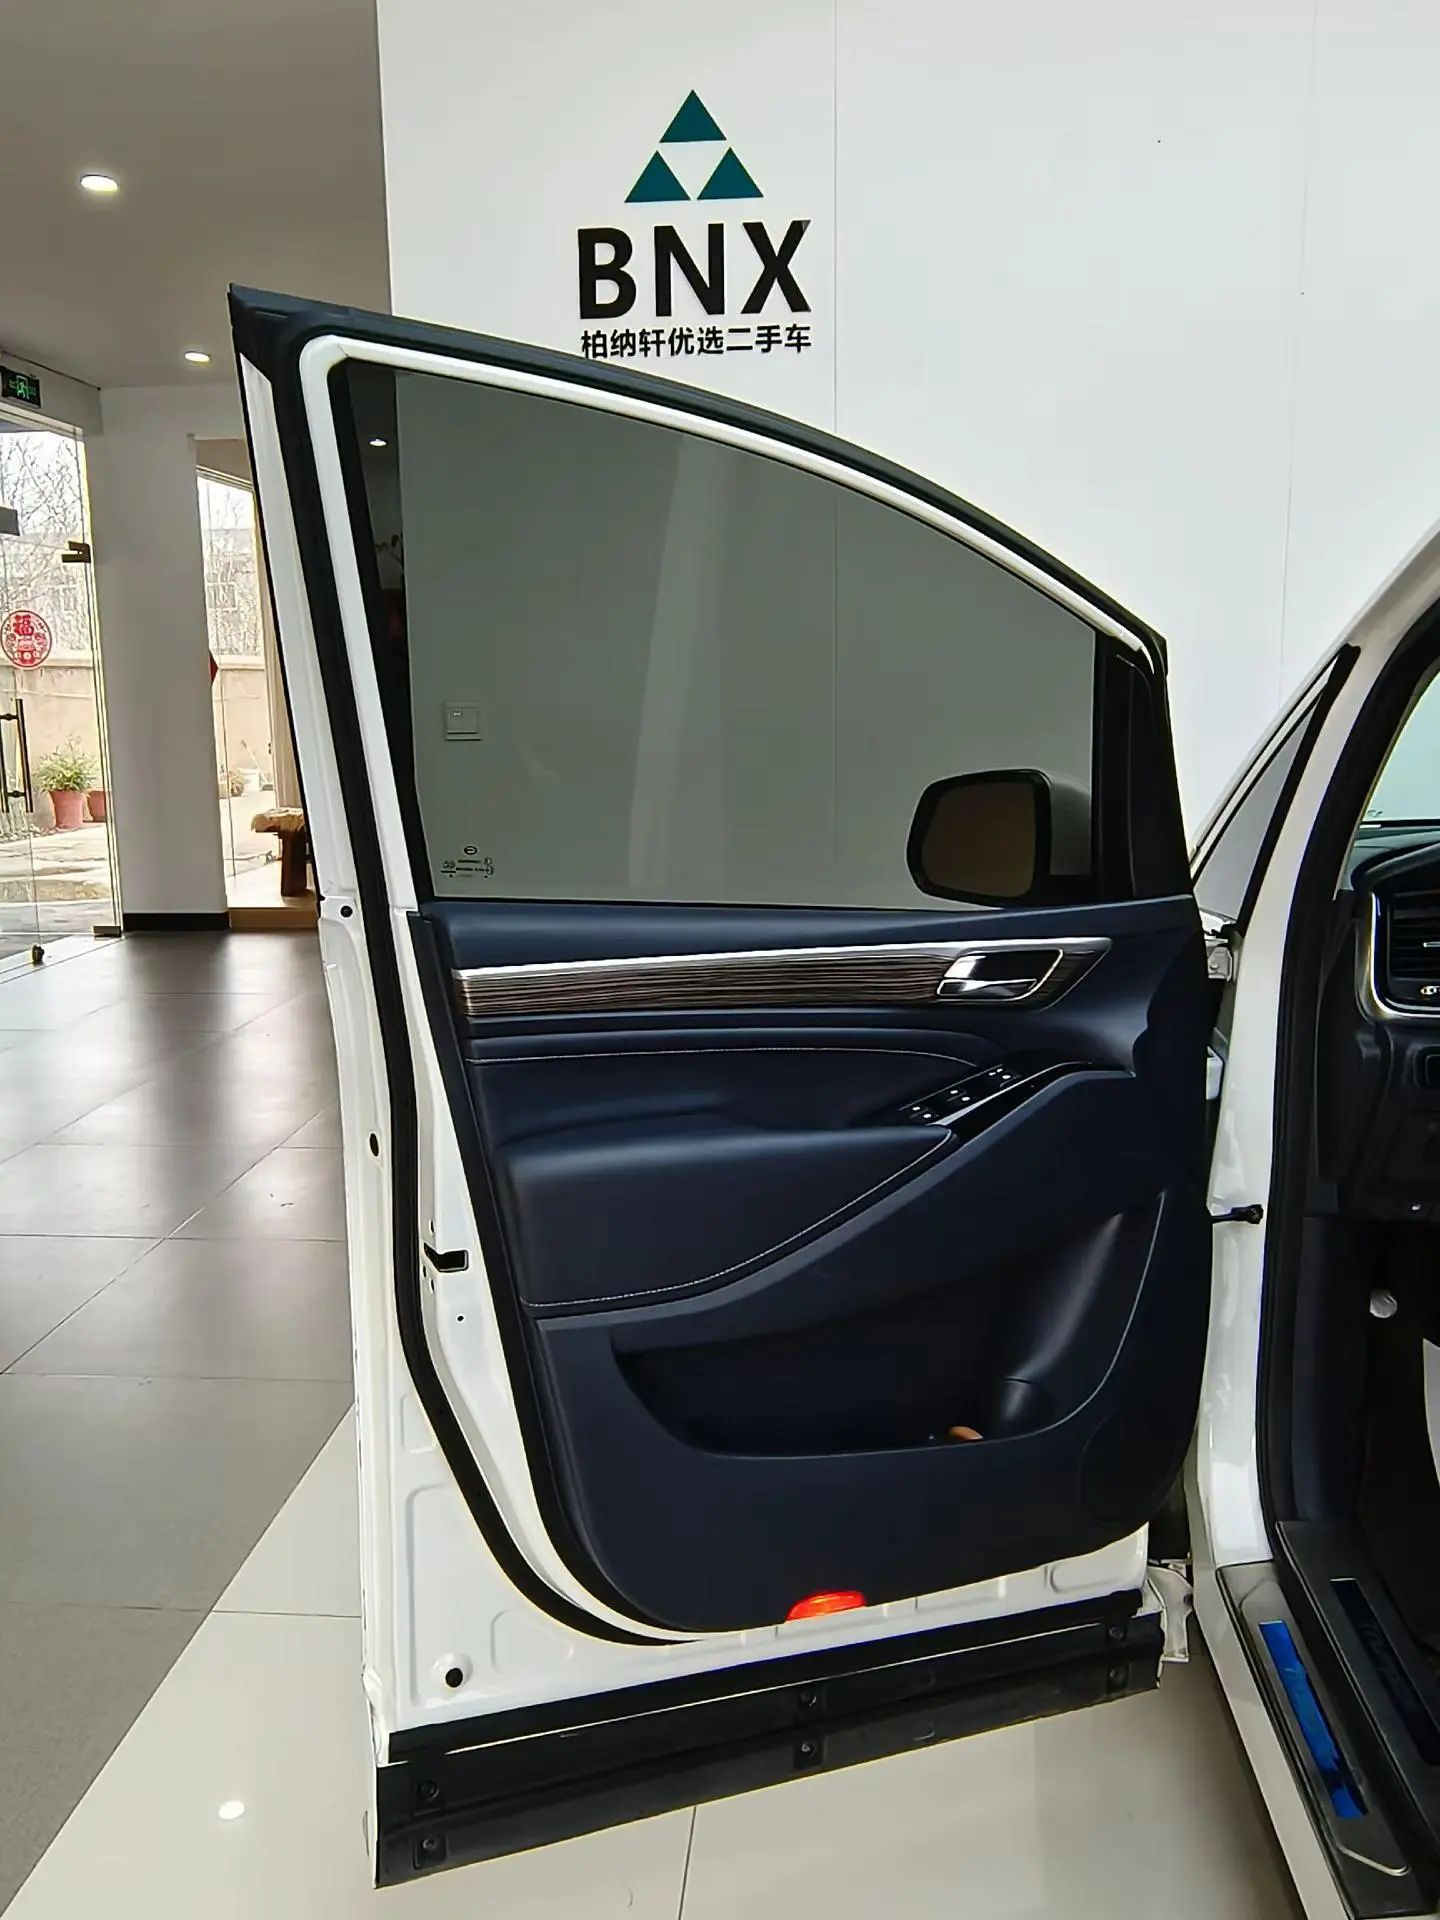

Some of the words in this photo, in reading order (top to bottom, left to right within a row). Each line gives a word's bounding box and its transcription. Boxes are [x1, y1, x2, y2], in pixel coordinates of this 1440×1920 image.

[577, 220, 812, 320] BNX
[581, 323, 812, 359] 柏纳轩优选二手车
